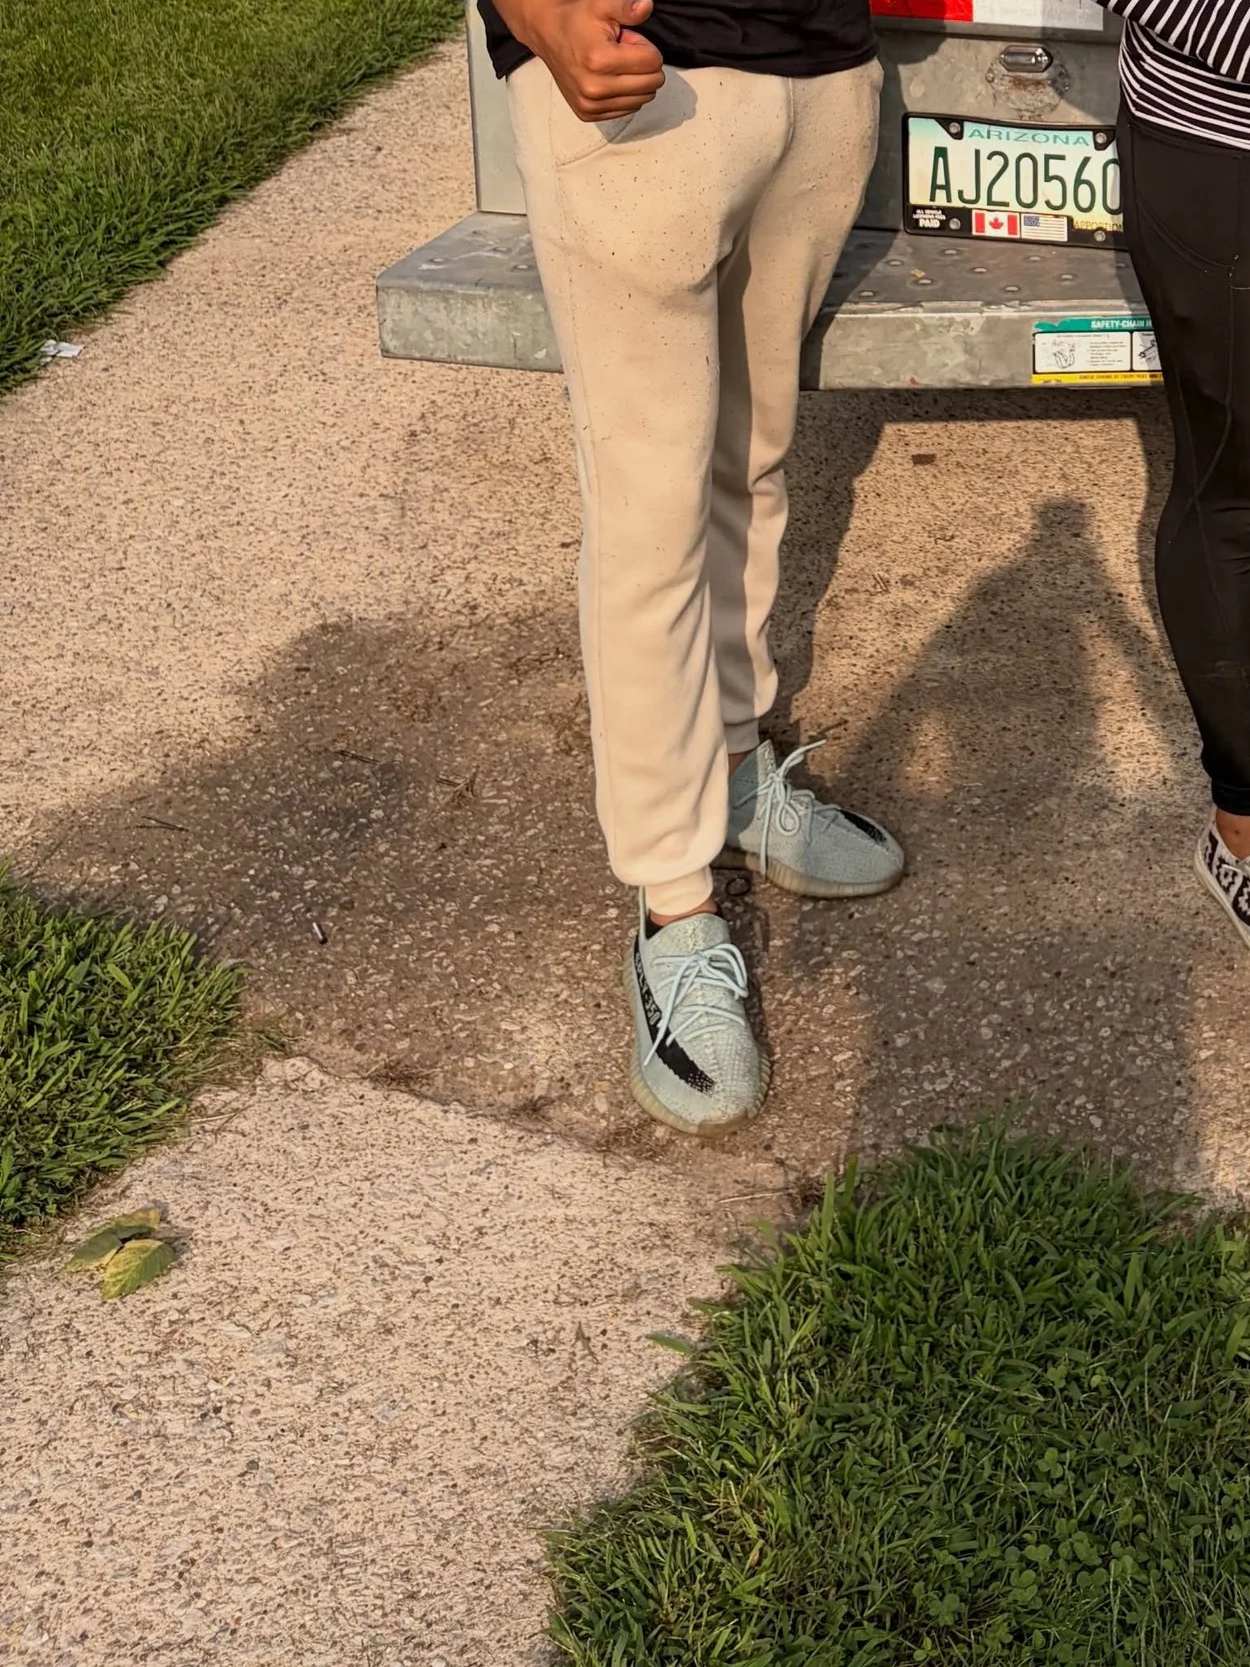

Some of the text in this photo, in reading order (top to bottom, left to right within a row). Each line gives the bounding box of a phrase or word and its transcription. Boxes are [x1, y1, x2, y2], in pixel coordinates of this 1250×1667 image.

[968, 128, 1090, 147] ARIZONA
[929, 145, 1122, 216] AJ20560
[919, 218, 941, 228] PAID
